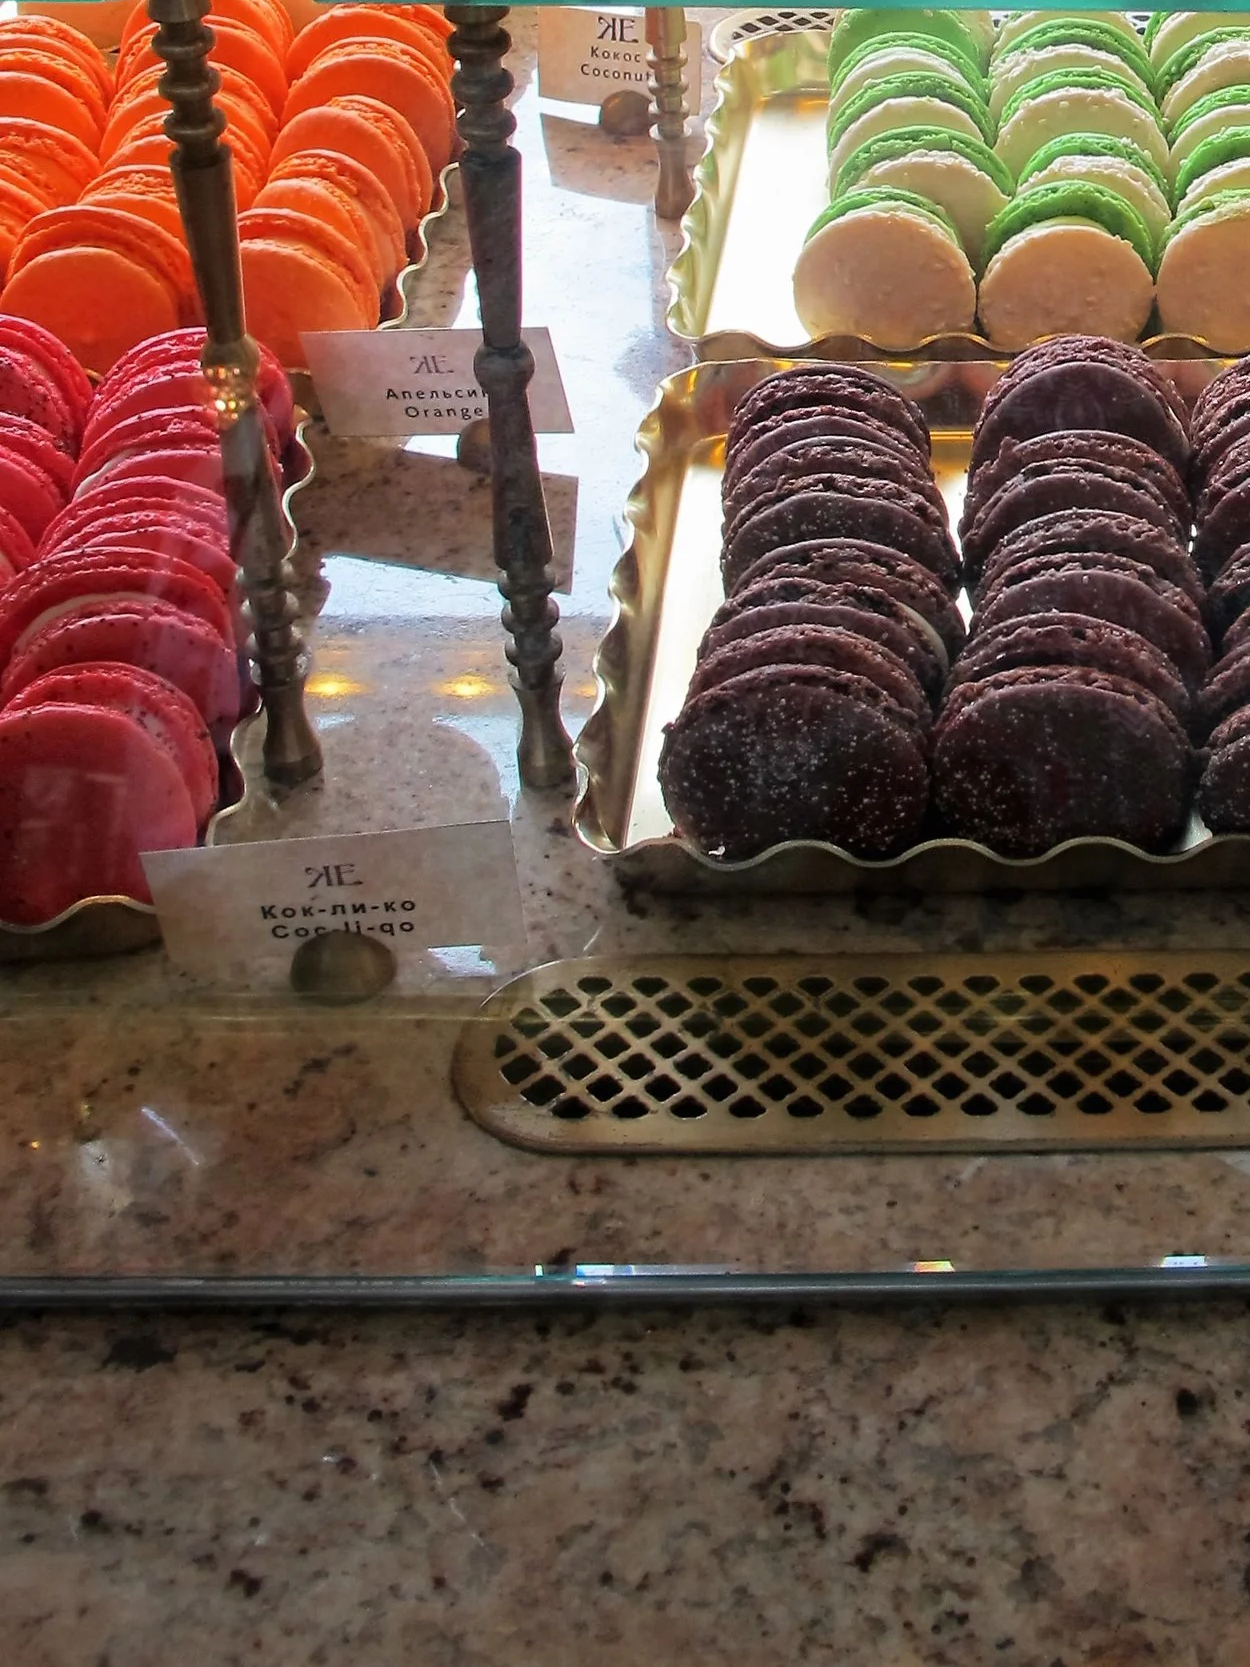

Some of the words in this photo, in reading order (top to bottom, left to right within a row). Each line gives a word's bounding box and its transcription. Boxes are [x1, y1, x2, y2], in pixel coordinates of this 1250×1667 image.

[590, 45, 642, 63] Кокос
[404, 405, 484, 421] Orange
[260, 899, 417, 920] Кок-ли-ко
